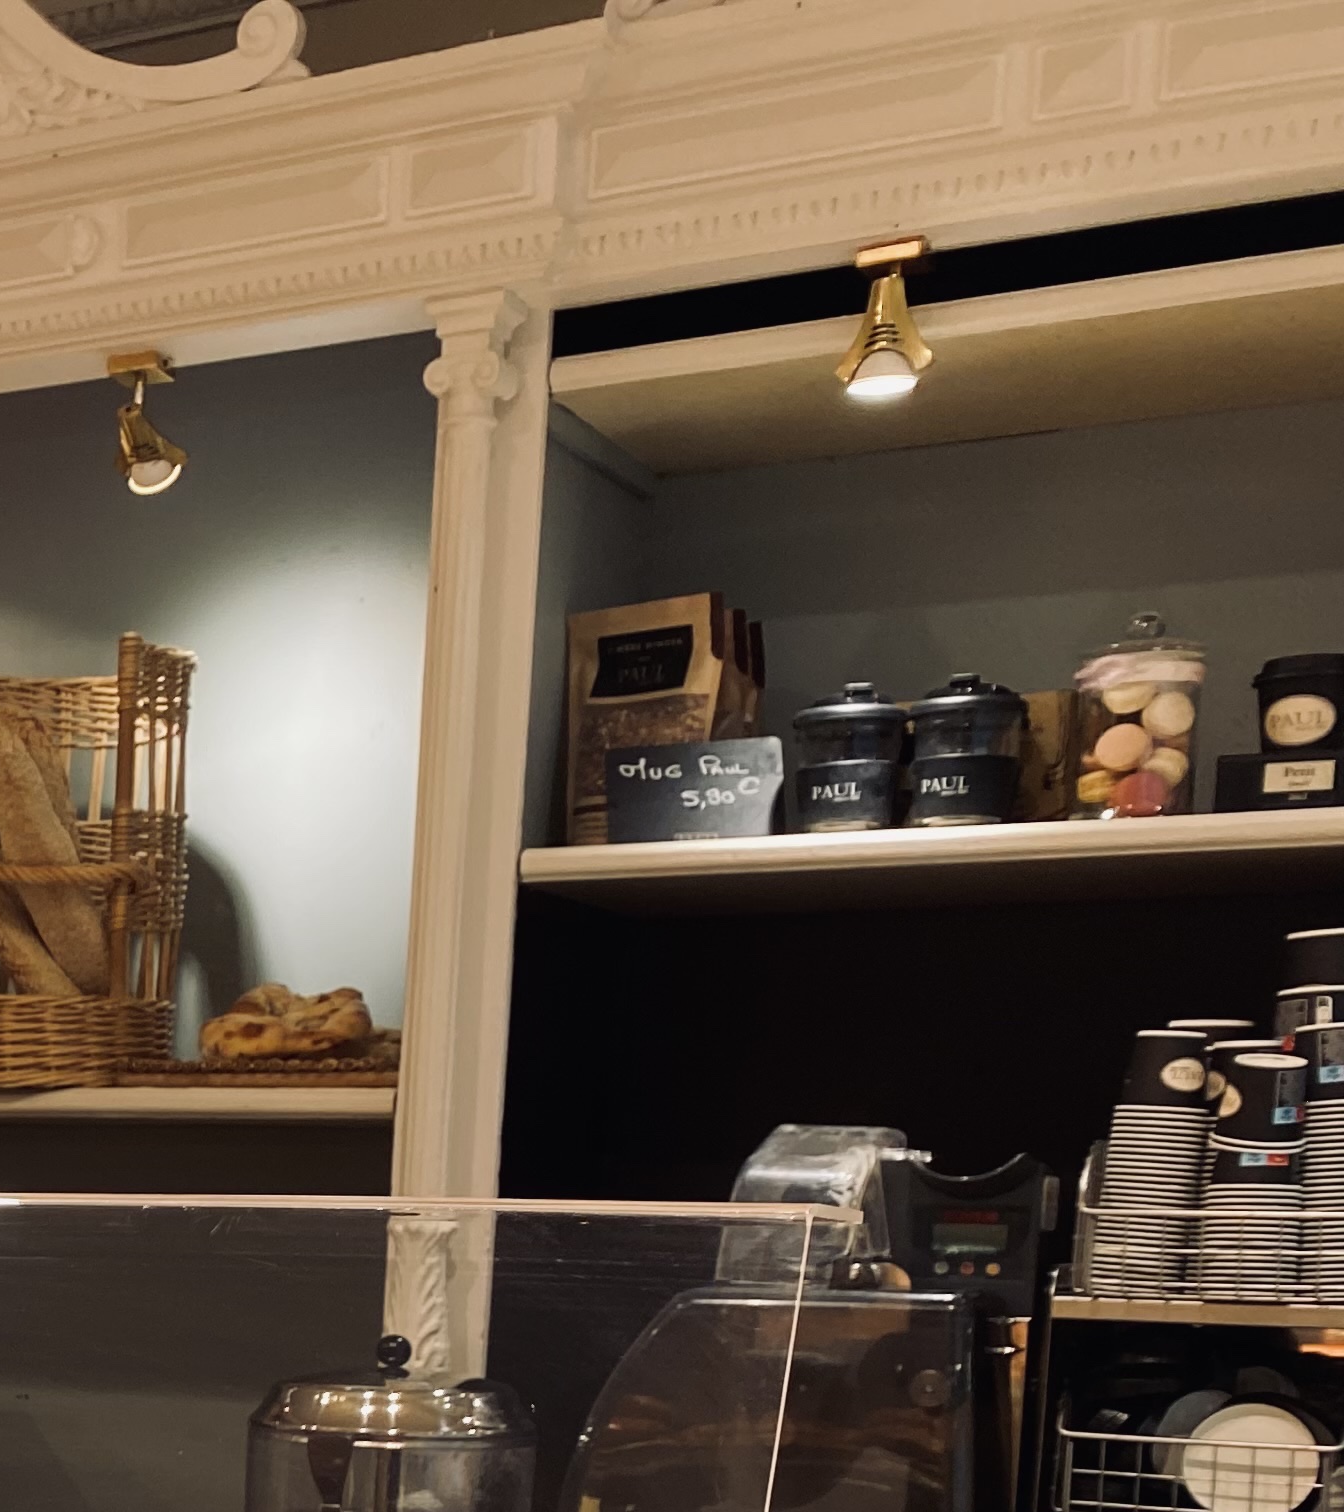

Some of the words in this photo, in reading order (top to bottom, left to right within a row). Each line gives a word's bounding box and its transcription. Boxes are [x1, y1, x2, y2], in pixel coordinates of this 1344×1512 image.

[1269, 711, 1326, 730] PAUL
[812, 782, 861, 802] PAUL
[921, 775, 969, 797] PAUL
